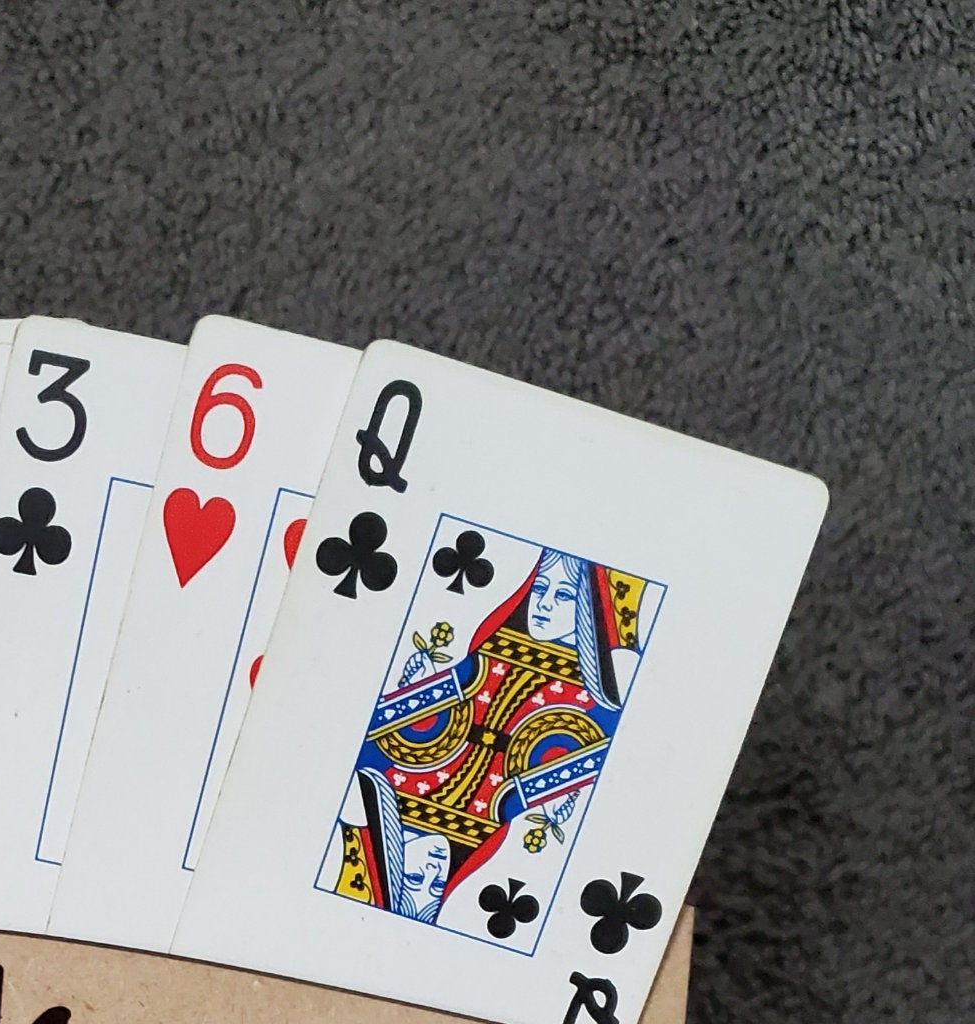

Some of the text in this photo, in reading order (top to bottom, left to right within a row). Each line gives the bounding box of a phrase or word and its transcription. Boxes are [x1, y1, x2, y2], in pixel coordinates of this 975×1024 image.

[14, 348, 91, 463] 3
[188, 361, 264, 471] 6
[354, 378, 424, 493] Q
